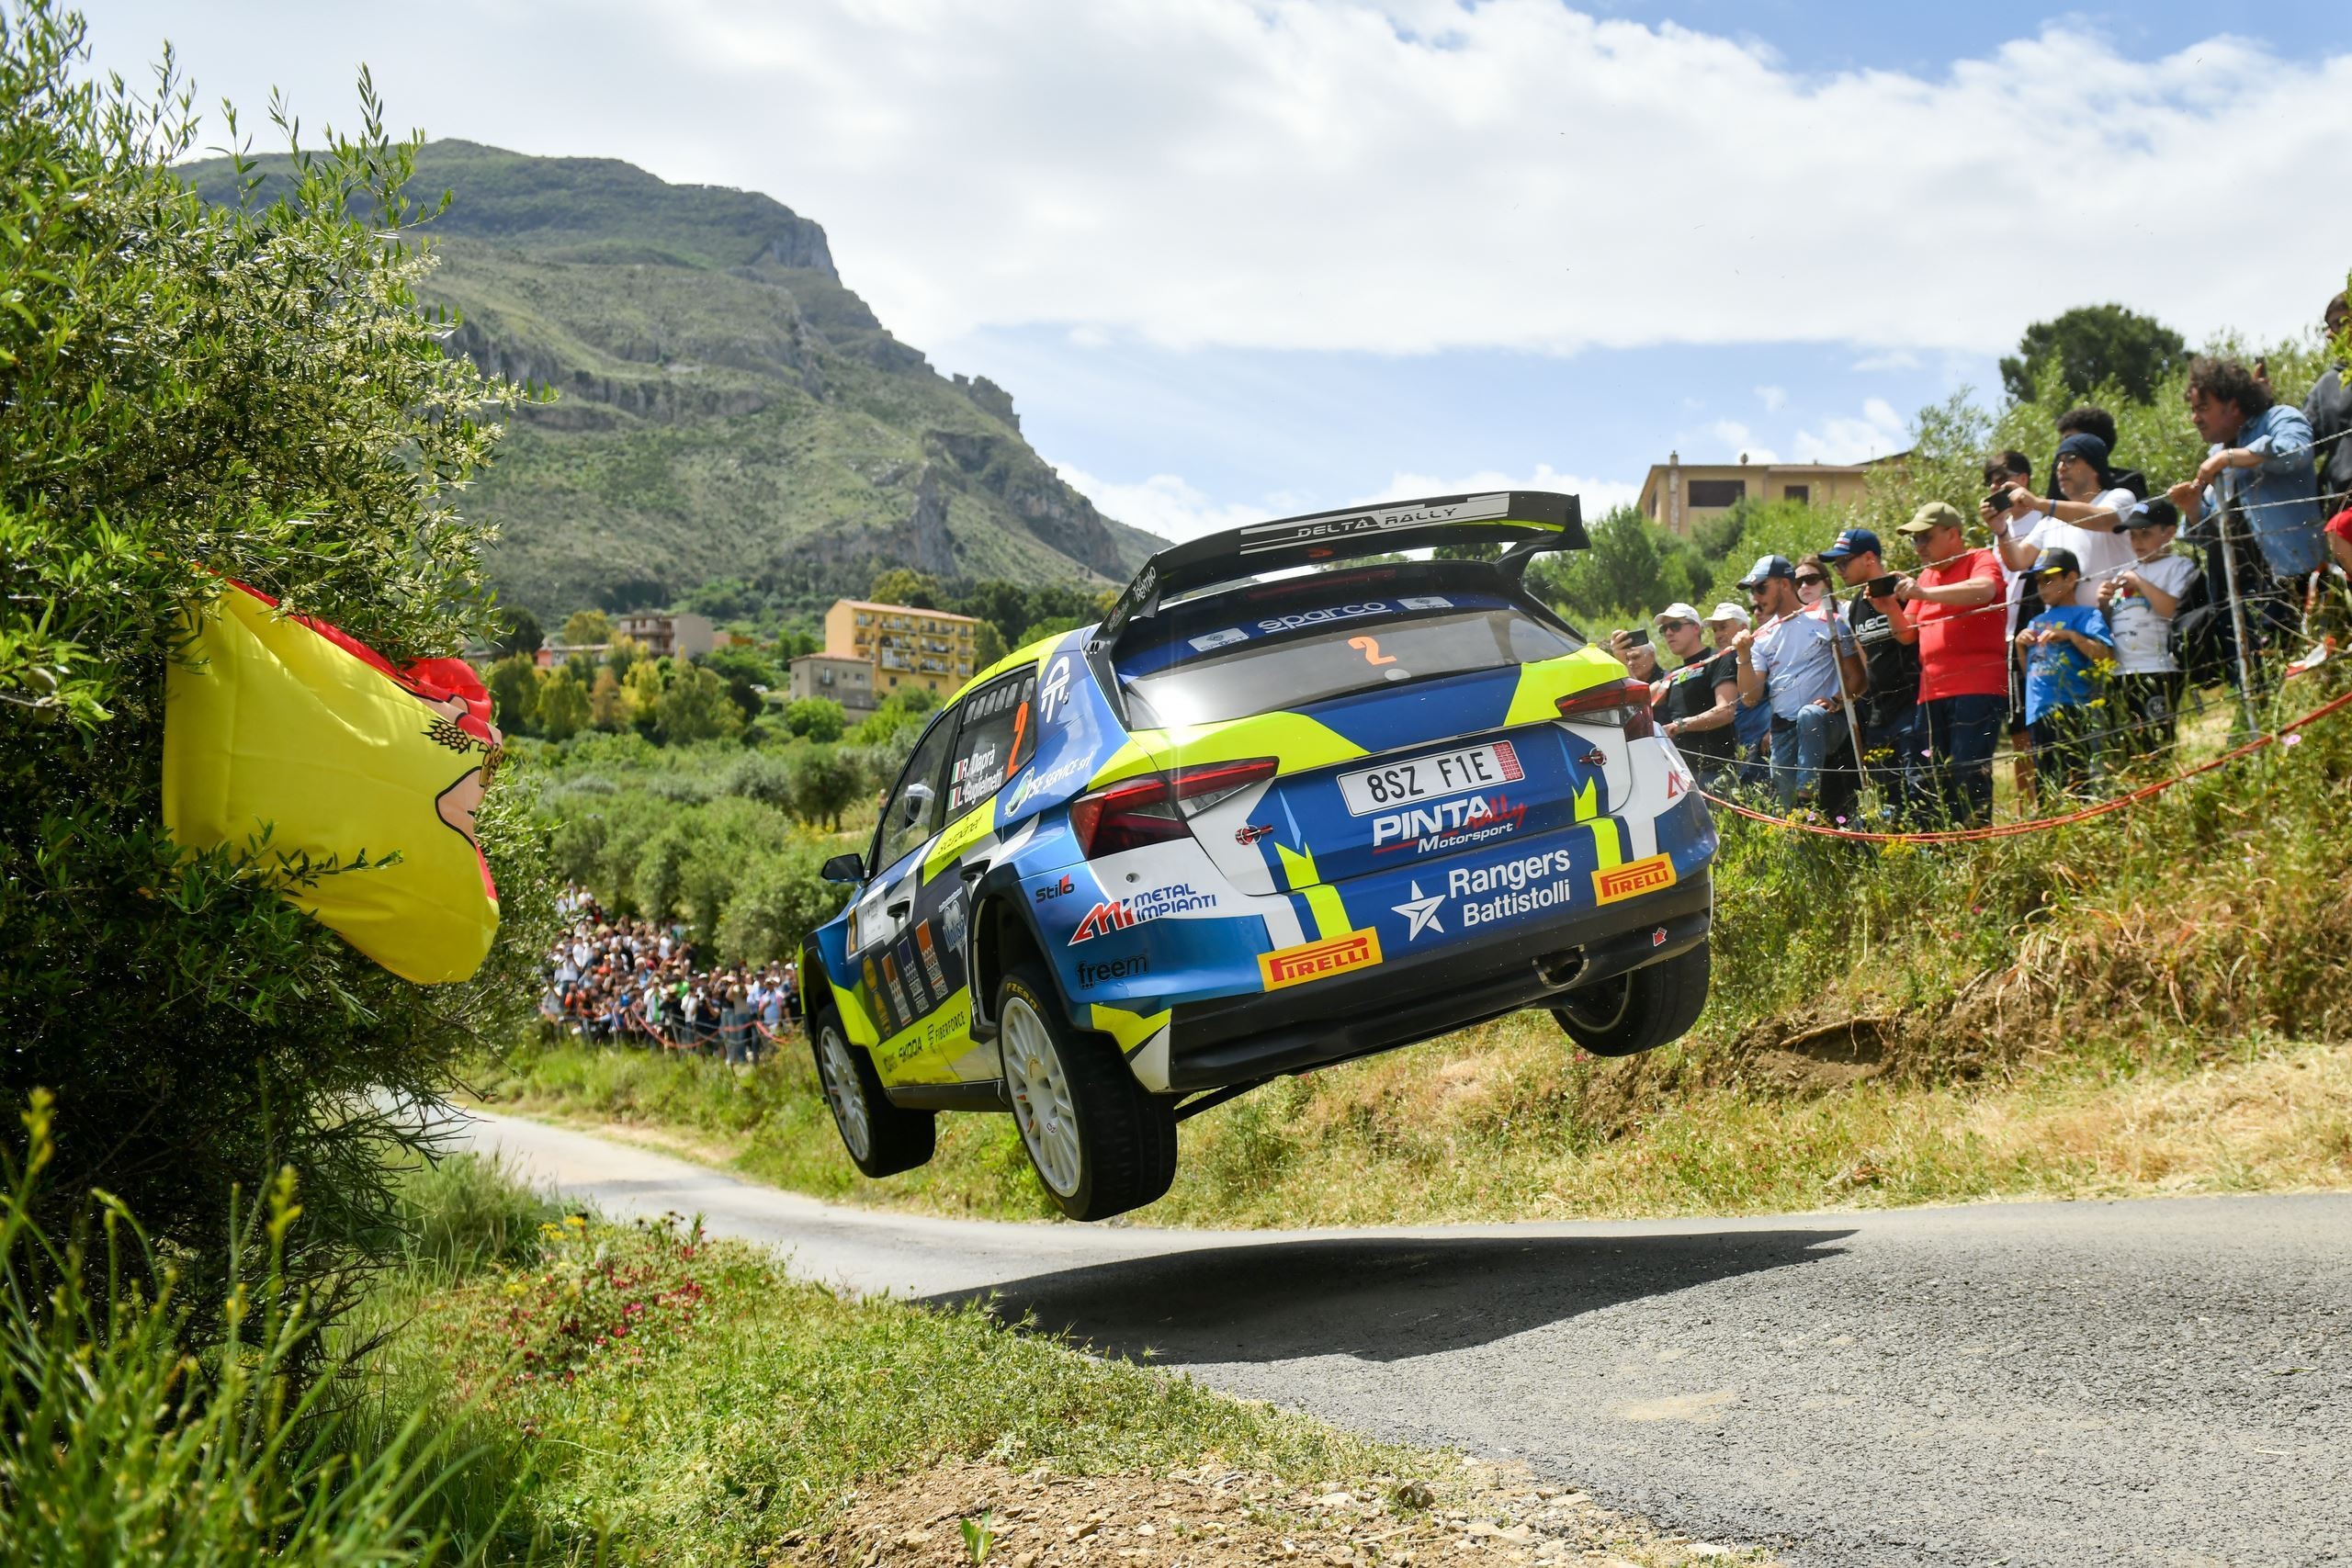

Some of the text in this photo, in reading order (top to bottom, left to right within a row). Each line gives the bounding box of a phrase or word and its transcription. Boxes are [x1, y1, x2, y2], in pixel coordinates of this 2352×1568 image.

[1297, 508, 1457, 537] DELTA RALLY
[1257, 601, 1387, 630] sparco
[1348, 636, 1397, 666] 2
[1006, 701, 1028, 780] 2
[1366, 751, 1493, 804] 8SZ F1E
[1373, 794, 1529, 847] PINTA rally
[1417, 821, 1514, 854] Motorsport
[1035, 874, 1075, 904] Stilo
[1449, 849, 1571, 898] Rangers
[1600, 861, 1669, 897] PIRELLI
[1134, 884, 1196, 908] METAL
[1136, 894, 1217, 922] IMPIANTI
[1463, 879, 1571, 928] Battistolli
[1076, 953, 1148, 989] freem
[1269, 937, 1370, 982] PIRELLI
[934, 1010, 966, 1043] FIBERFORCE
